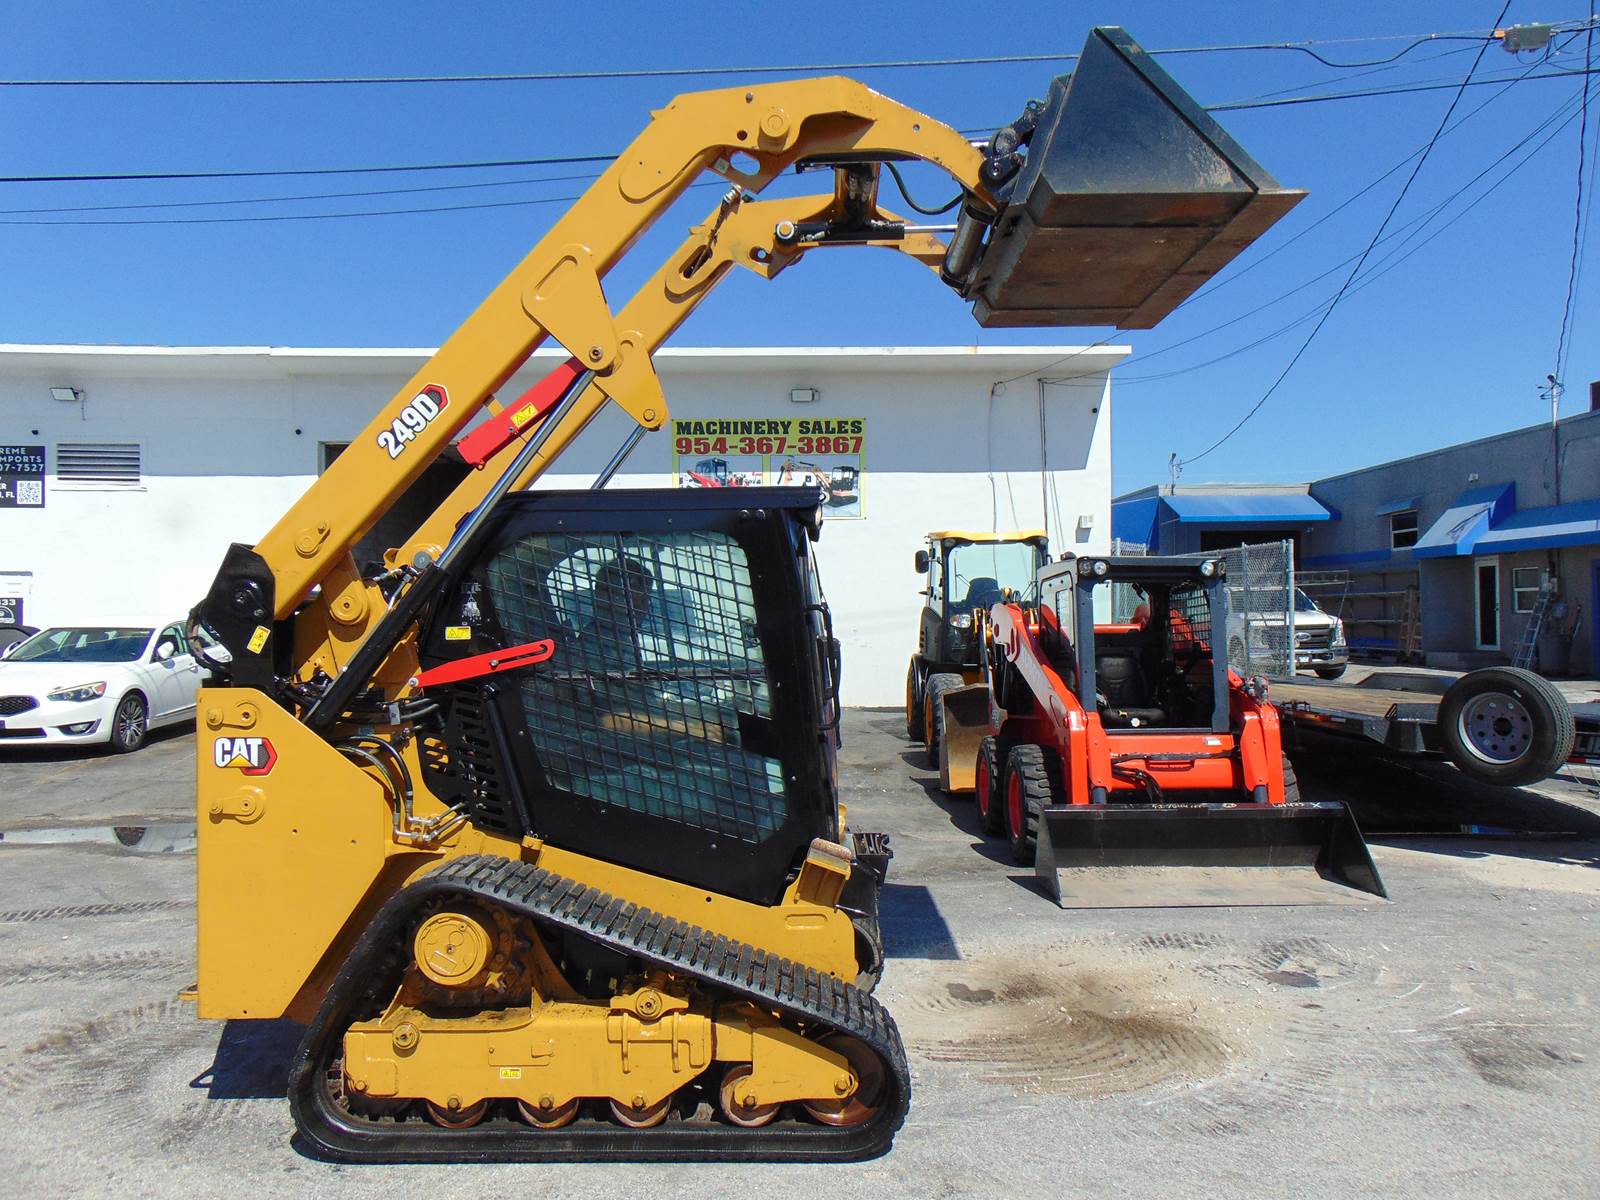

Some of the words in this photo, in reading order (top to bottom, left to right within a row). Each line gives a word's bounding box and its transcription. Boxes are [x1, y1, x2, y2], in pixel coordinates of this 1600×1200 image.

[377, 393, 439, 459] 249D
[676, 420, 792, 435] MACHINERY
[799, 420, 863, 435] SALES
[675, 436, 863, 455] 954-367-3867
[215, 737, 263, 767] CAT
